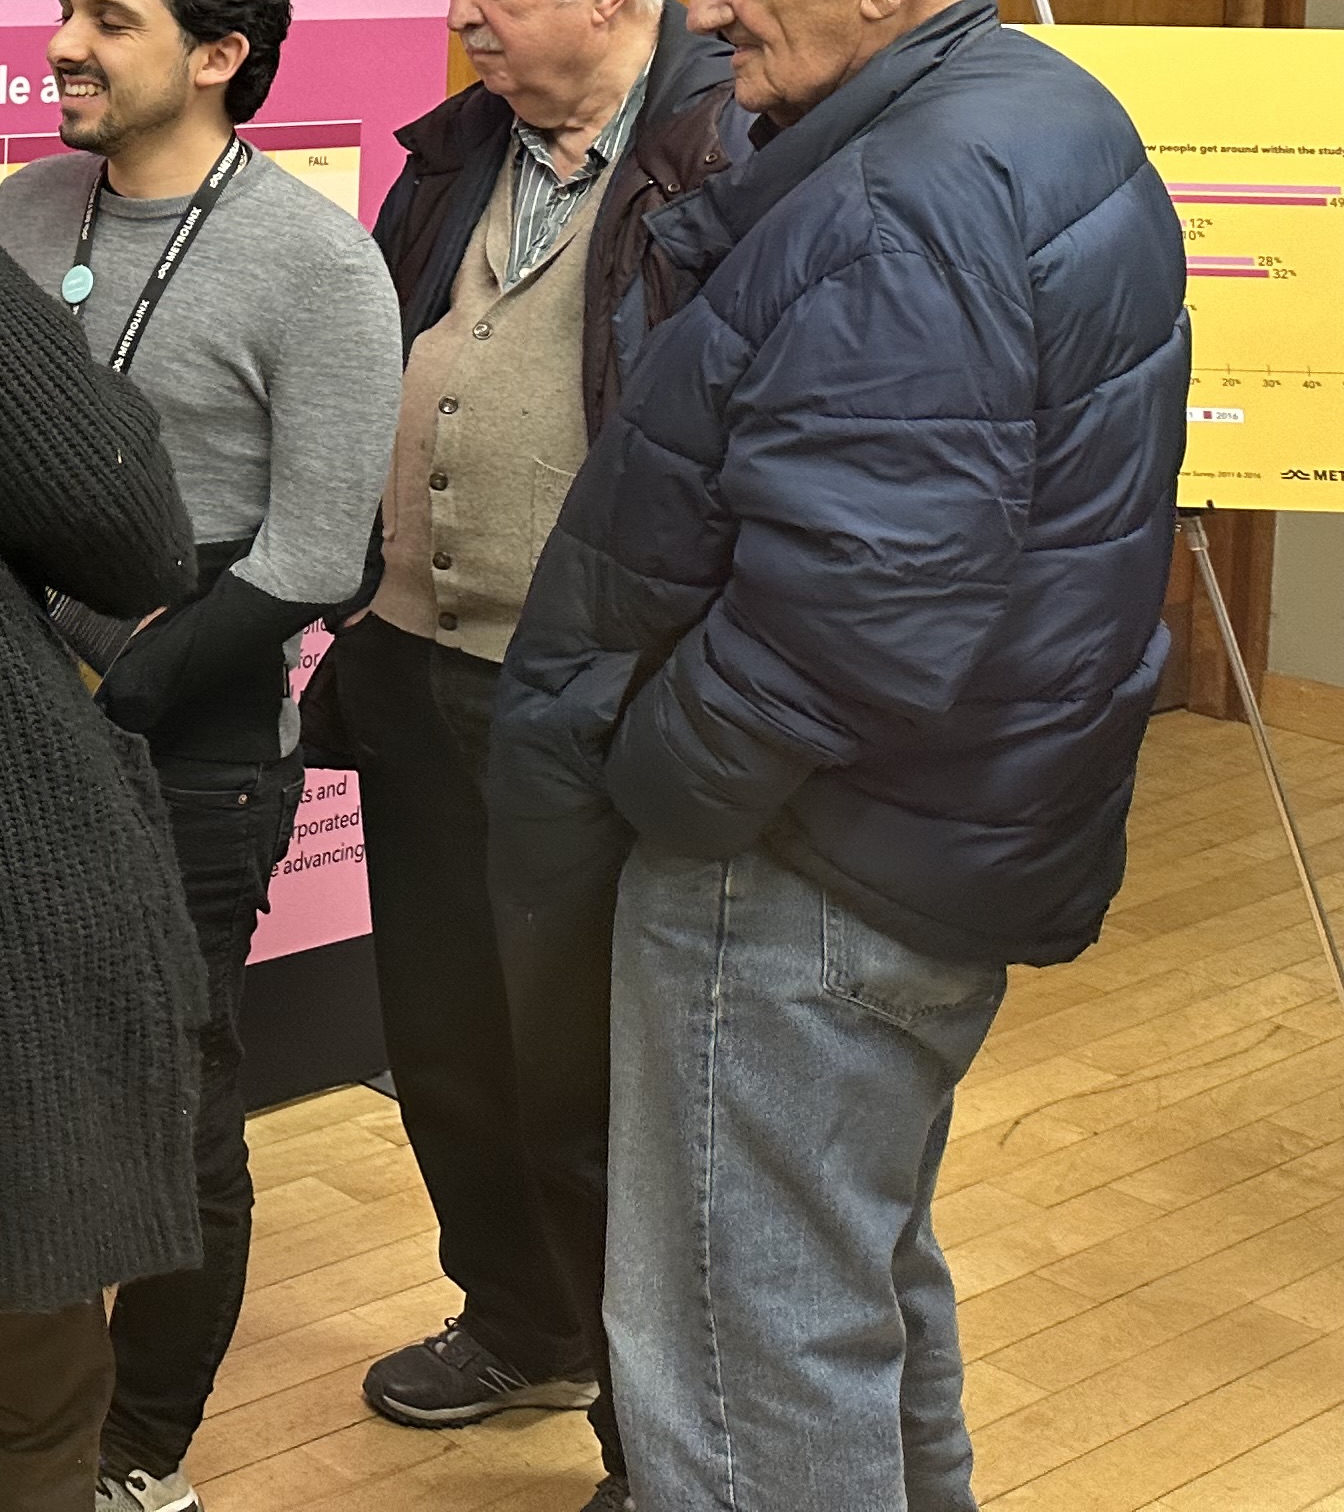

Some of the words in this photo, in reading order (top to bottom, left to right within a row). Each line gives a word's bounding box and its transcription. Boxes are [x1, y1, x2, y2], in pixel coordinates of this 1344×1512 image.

[308, 156, 329, 167] FALL
[1189, 217, 1214, 229] 12%
[165, 206, 202, 262] METROLINX
[1257, 255, 1284, 267] 28%
[1272, 268, 1297, 280] 32%
[117, 299, 150, 357] METROLINX
[316, 774, 348, 801] and
[282, 841, 365, 876] advancing
